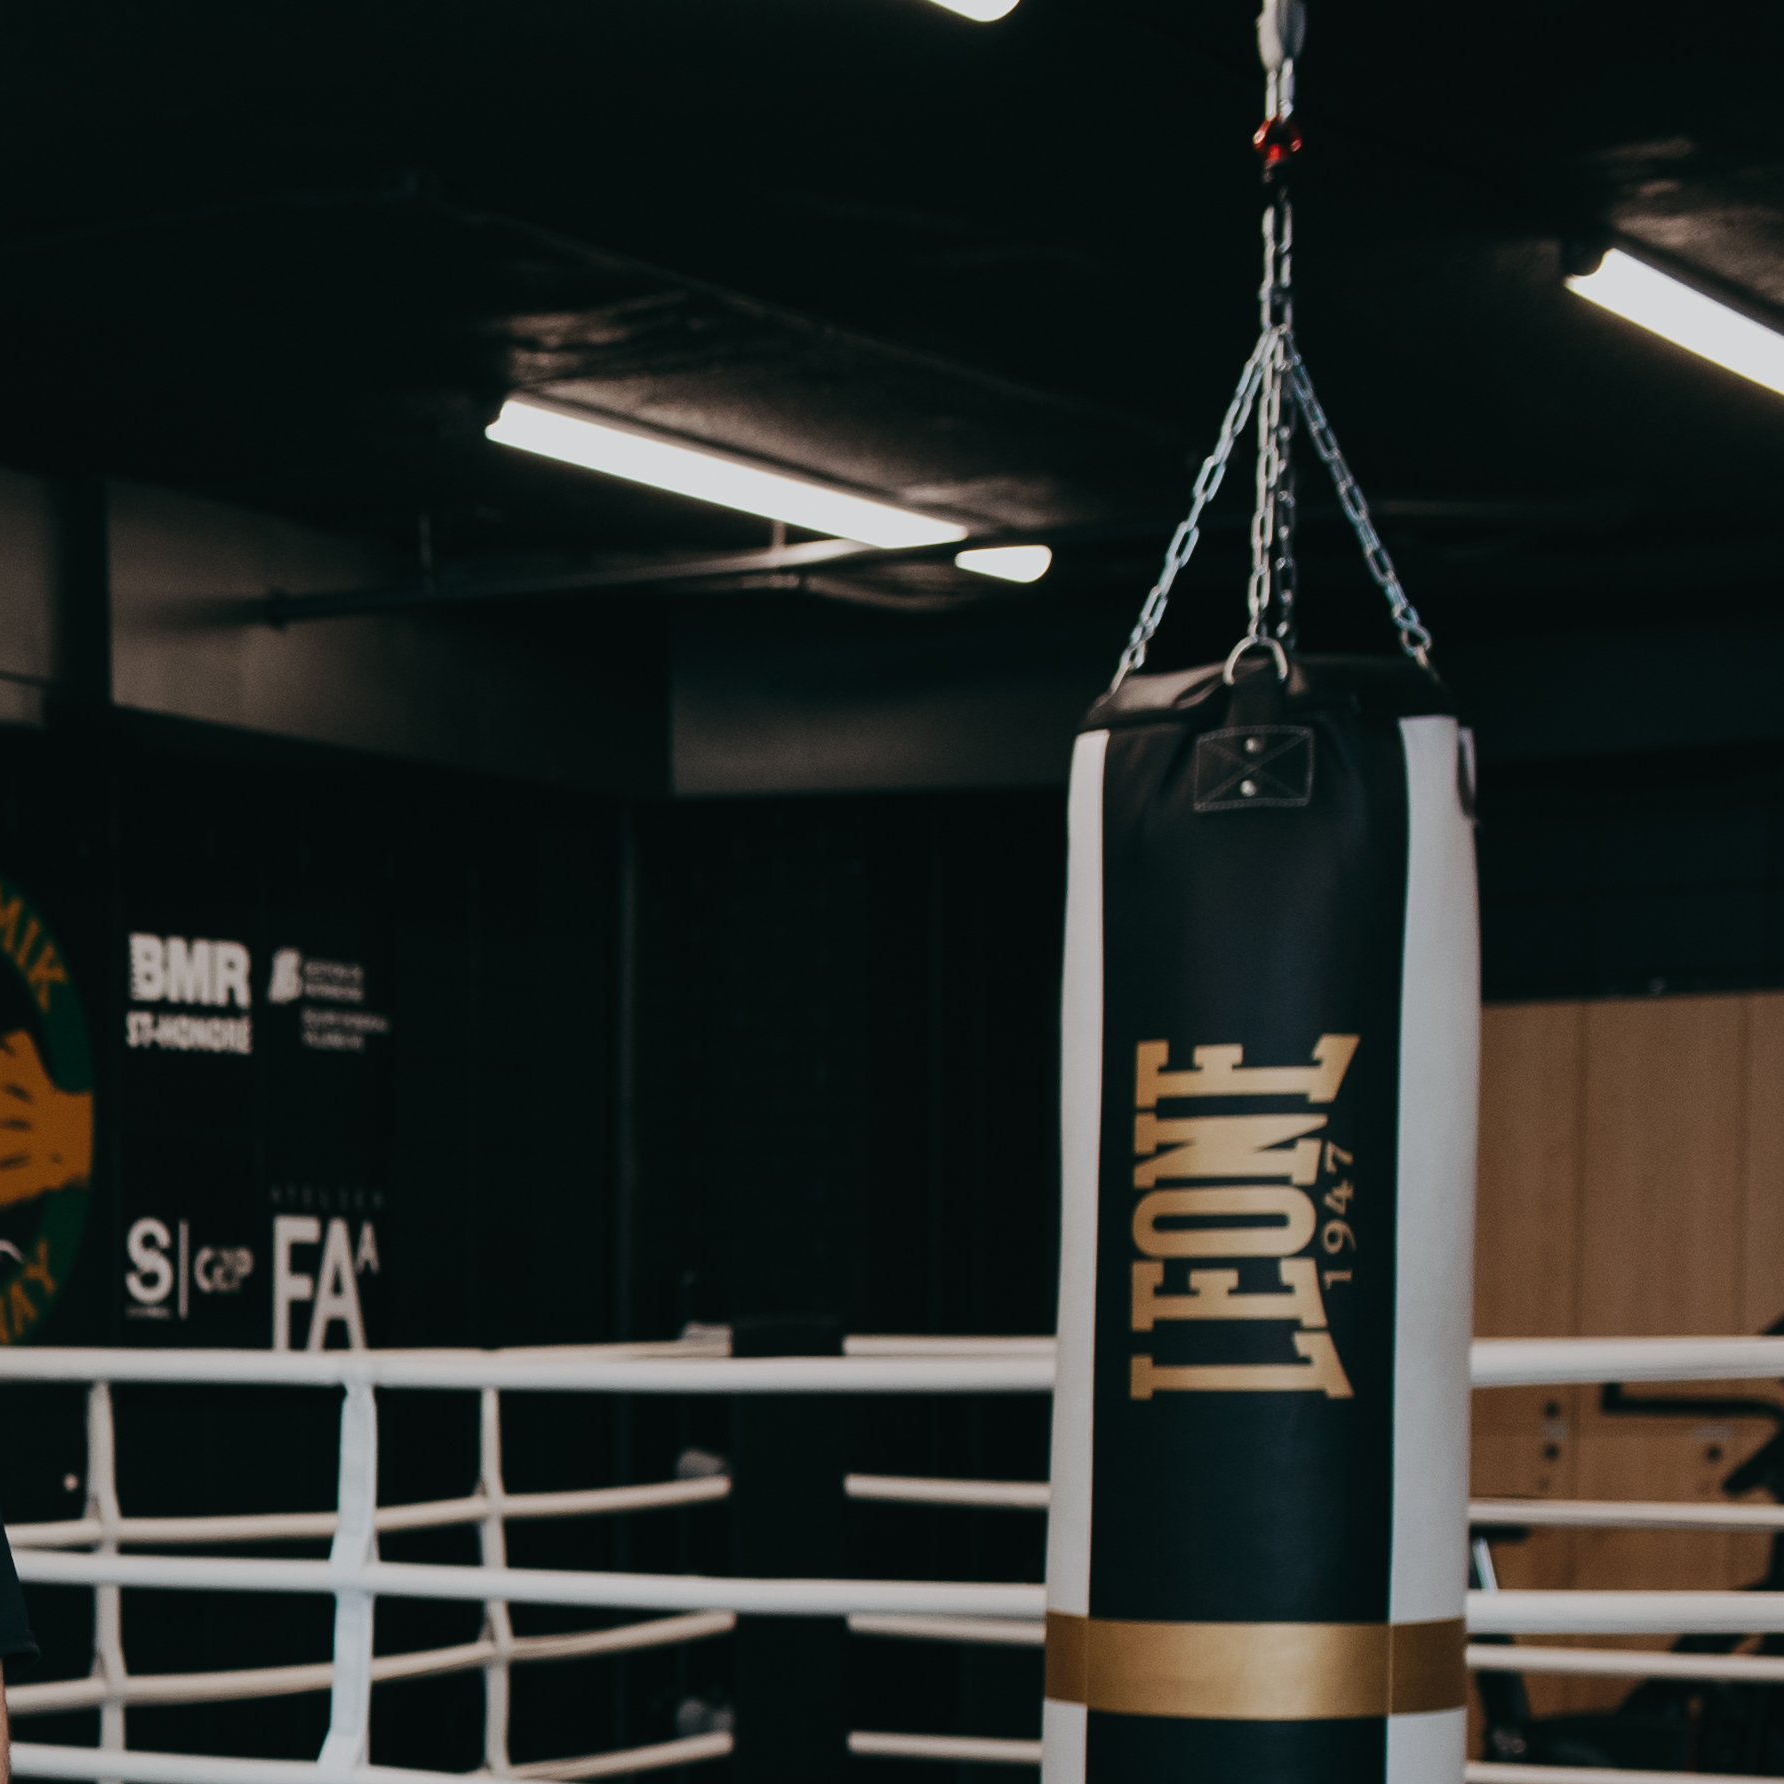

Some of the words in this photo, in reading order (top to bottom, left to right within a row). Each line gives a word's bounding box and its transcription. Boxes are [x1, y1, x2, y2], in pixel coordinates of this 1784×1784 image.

[128, 931, 252, 1011] BMR
[1130, 1033, 1361, 1401] LEONE
[1321, 1142, 1357, 1291] 1947
